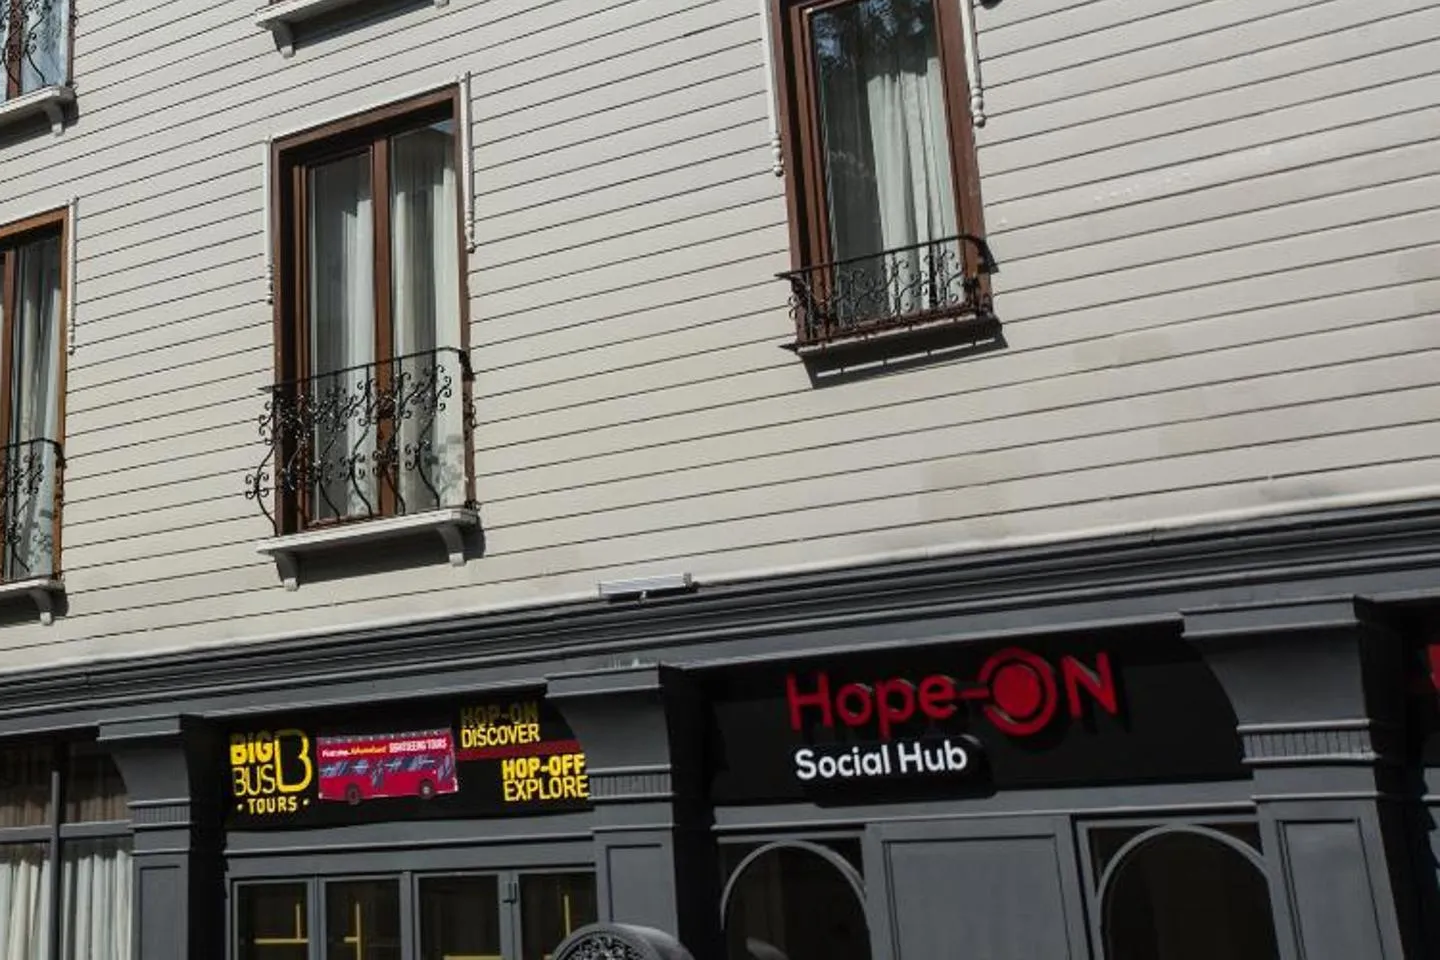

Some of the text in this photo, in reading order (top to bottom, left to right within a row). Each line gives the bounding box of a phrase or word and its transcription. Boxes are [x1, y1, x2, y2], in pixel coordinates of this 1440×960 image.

[786, 646, 1118, 741] Hope-ON
[461, 701, 539, 726] HOP-ON
[230, 732, 274, 766] BIG
[461, 723, 541, 749] DISCOVER
[501, 753, 587, 781] HOP-OFF
[795, 739, 968, 780] Social Hub
[232, 764, 275, 797] BUS
[503, 775, 590, 803] EXPLORE
[247, 797, 298, 815] TOURS
